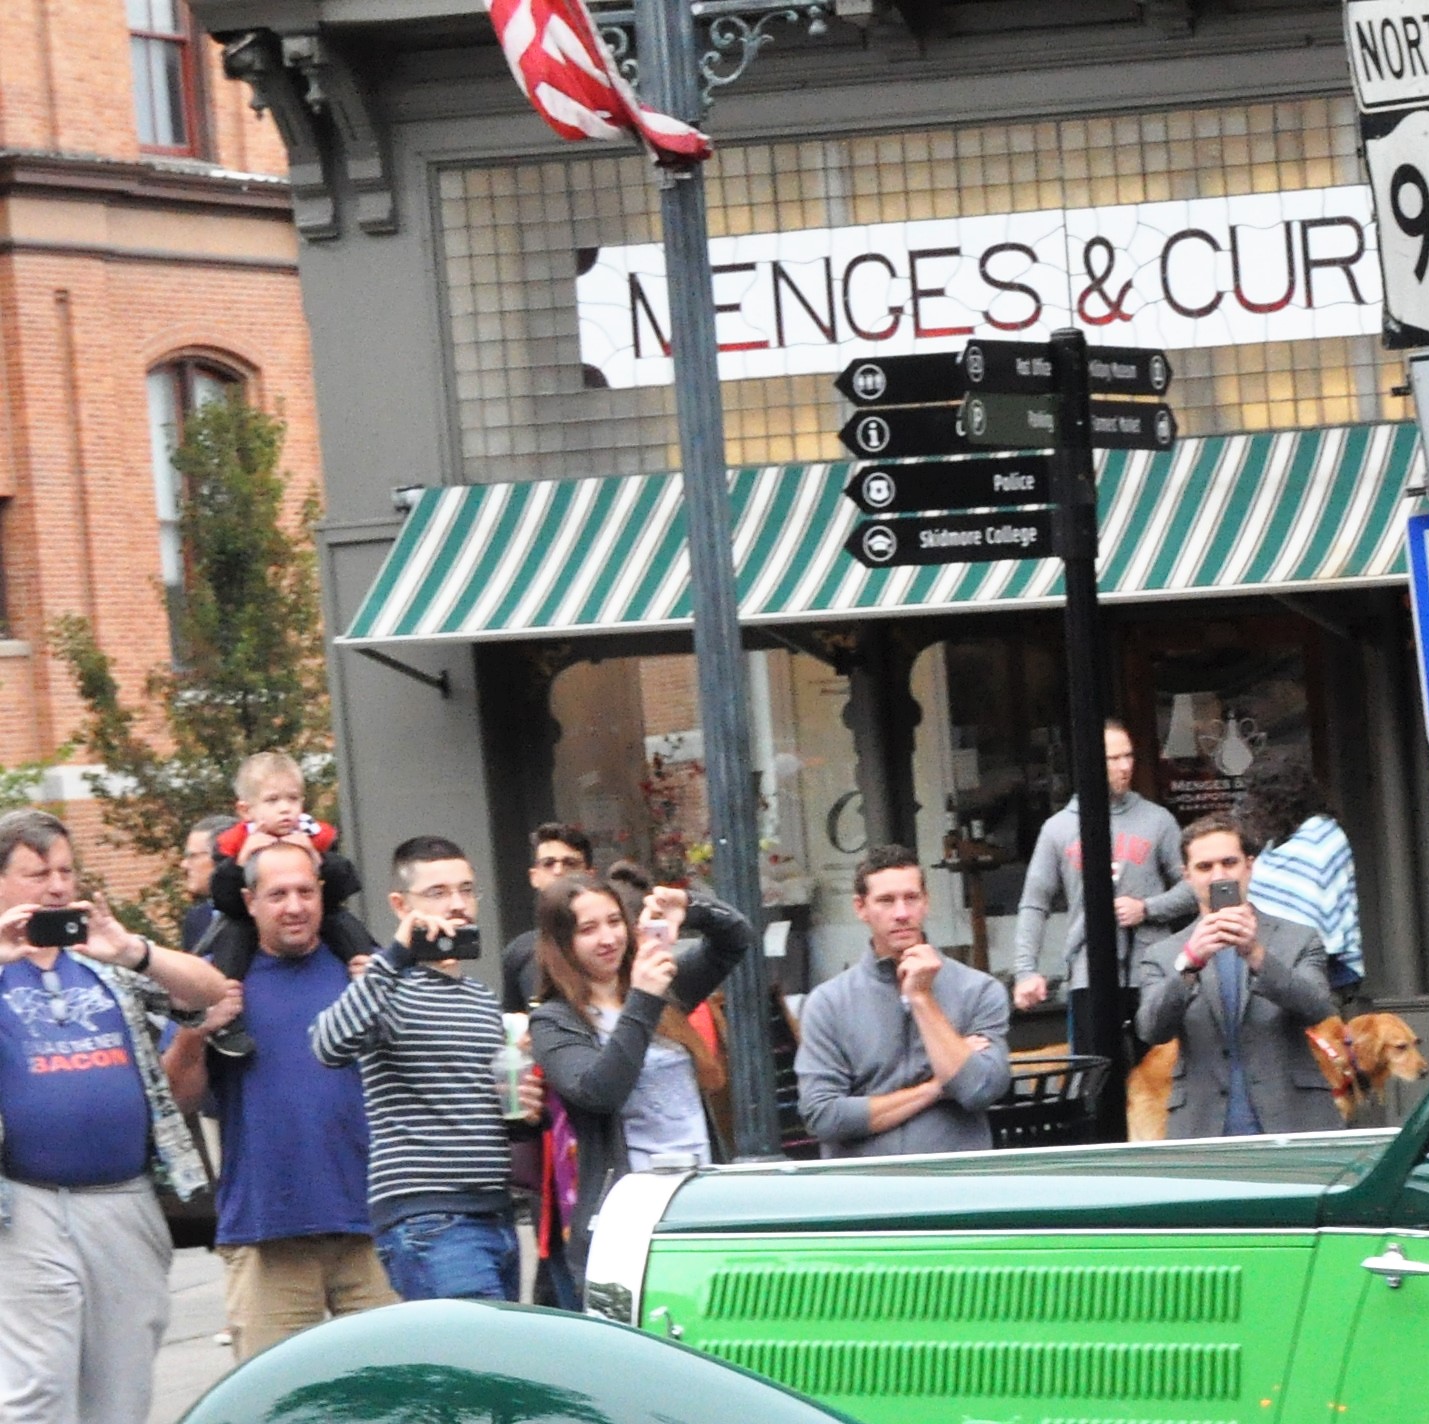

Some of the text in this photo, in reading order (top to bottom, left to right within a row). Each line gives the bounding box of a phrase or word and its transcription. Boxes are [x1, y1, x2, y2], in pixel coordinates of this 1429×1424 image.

[1078, 236, 1134, 326] &
[993, 472, 1036, 493] Police
[919, 525, 1038, 549] Skidmore College
[29, 1048, 128, 1073] BACON
